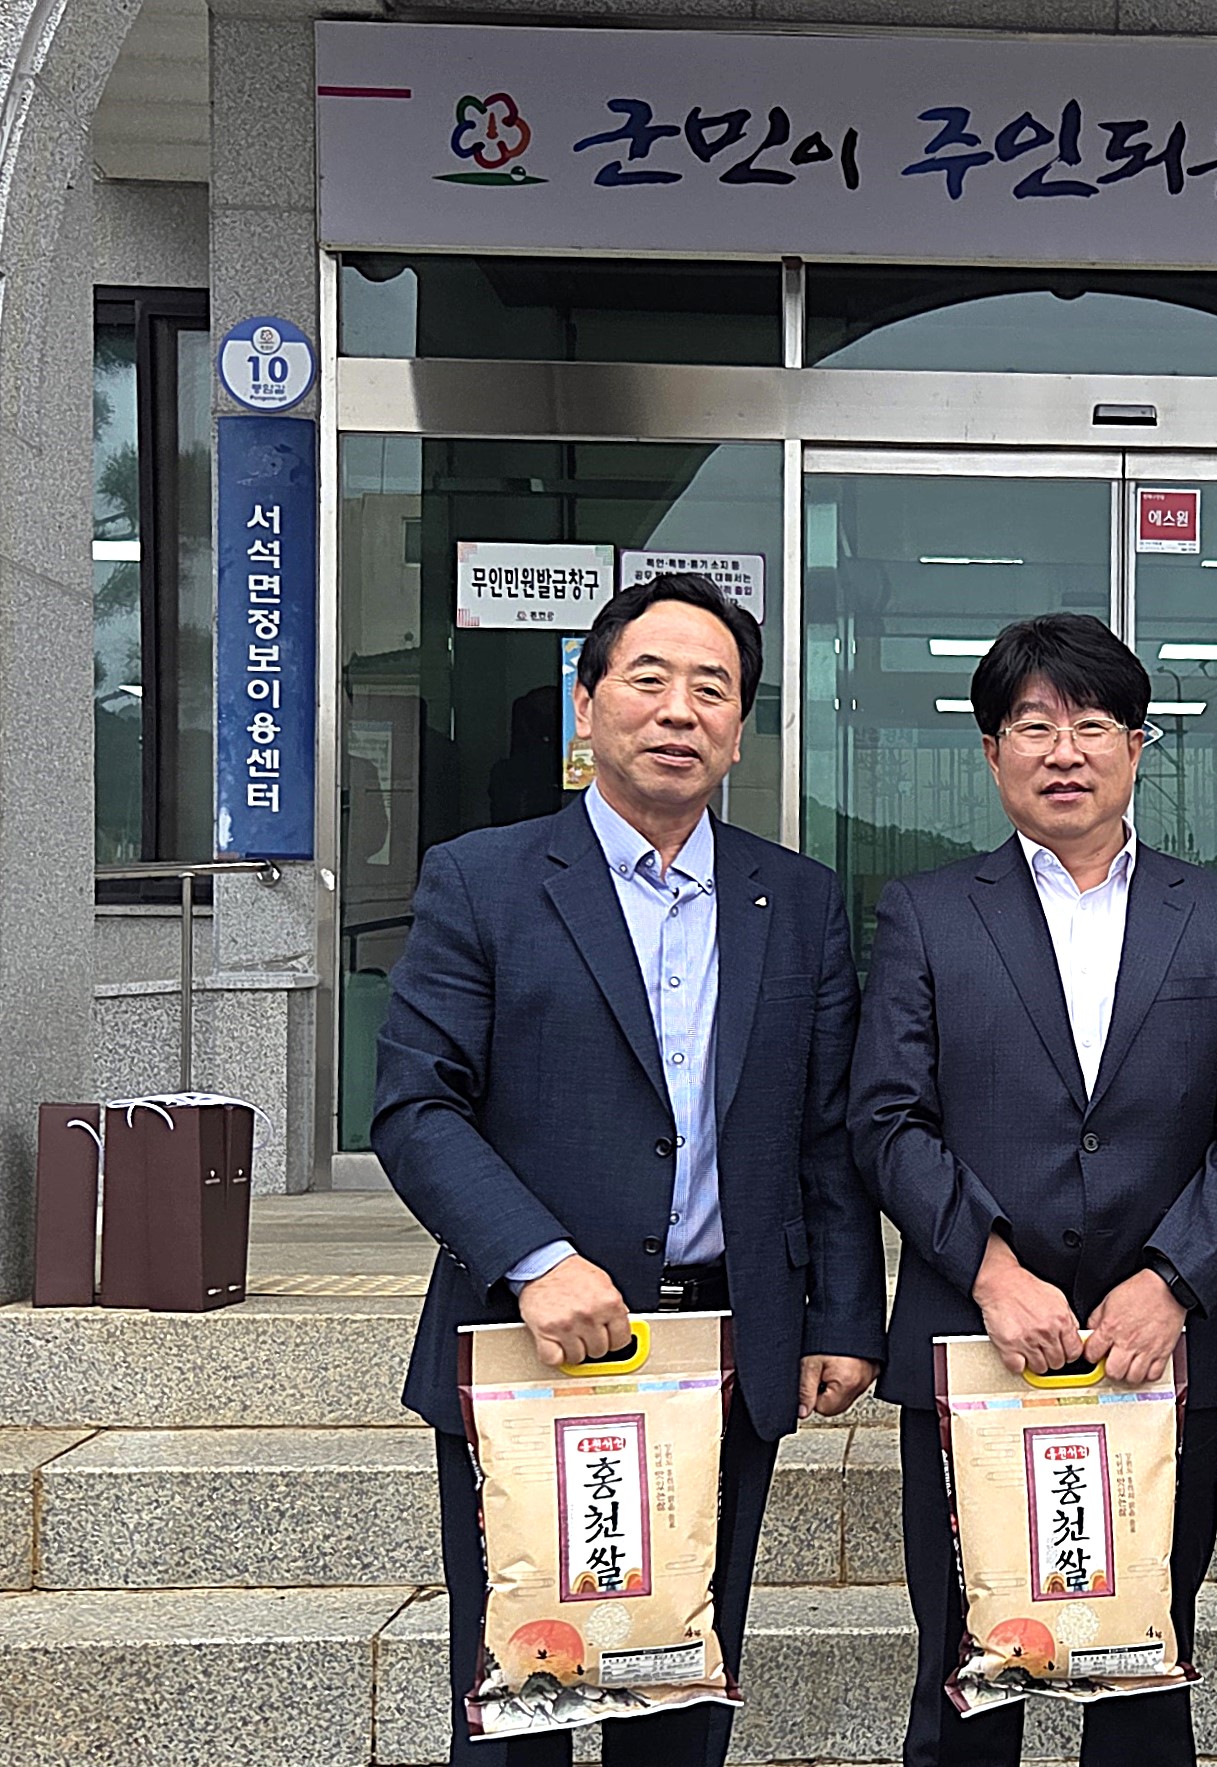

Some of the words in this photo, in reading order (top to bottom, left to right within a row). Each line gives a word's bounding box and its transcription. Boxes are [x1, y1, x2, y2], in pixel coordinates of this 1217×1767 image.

[572, 98, 859, 190] 군민이
[247, 356, 288, 383] 10
[1148, 510, 1189, 527] 에스원
[471, 567, 600, 600] 무인민원발급창구
[246, 504, 282, 813] 서석면정보이용센터
[583, 1456, 626, 1588] 홍천쌀
[1051, 1464, 1091, 1588] 홍천쌀
